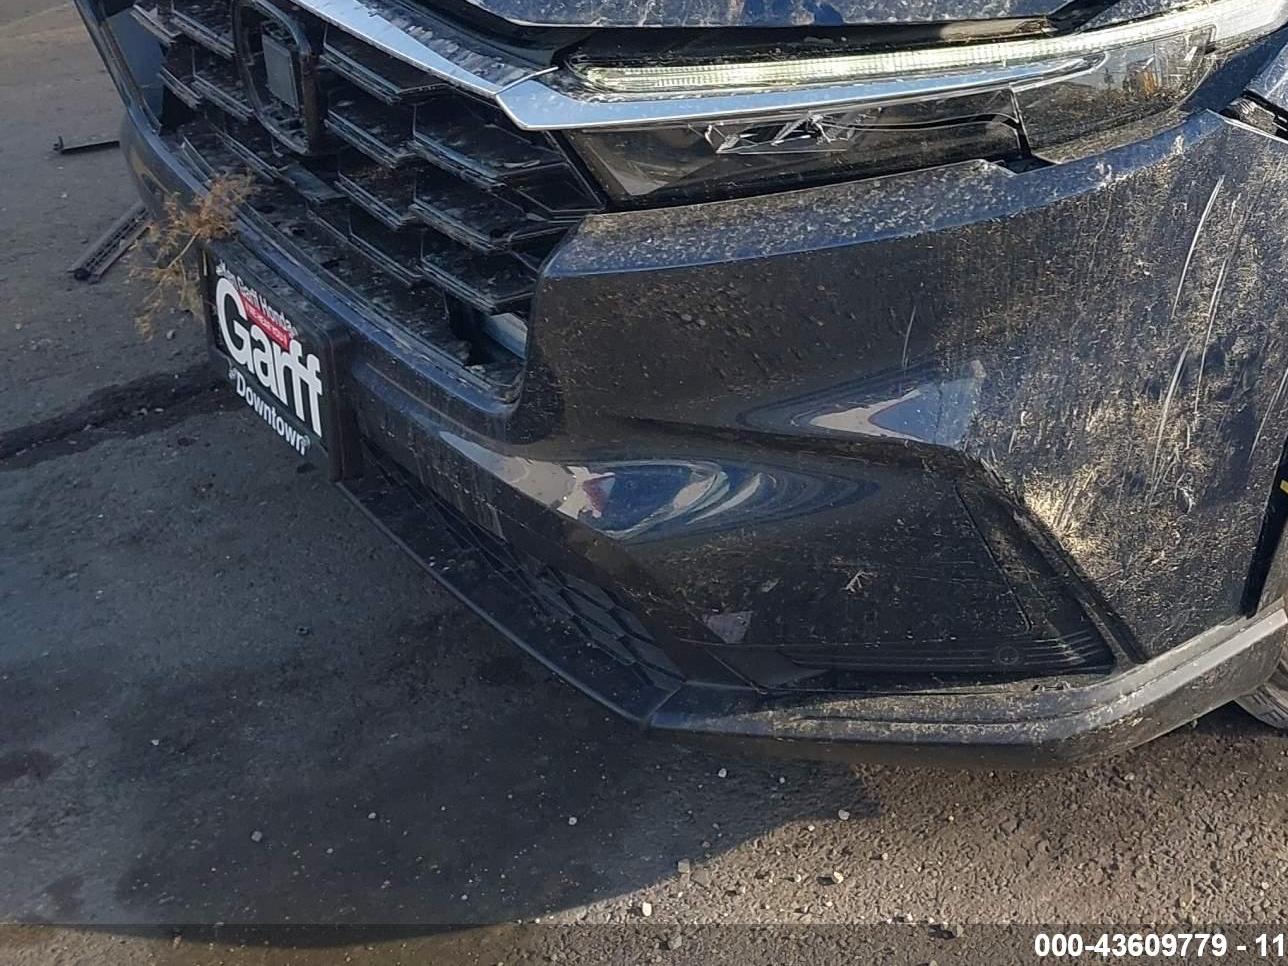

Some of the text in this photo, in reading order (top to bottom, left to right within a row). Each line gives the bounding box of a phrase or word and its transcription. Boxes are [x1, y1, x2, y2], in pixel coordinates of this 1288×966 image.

[259, 294, 292, 333] Honda
[215, 277, 323, 438] Garff
[235, 370, 306, 456] Downtown
